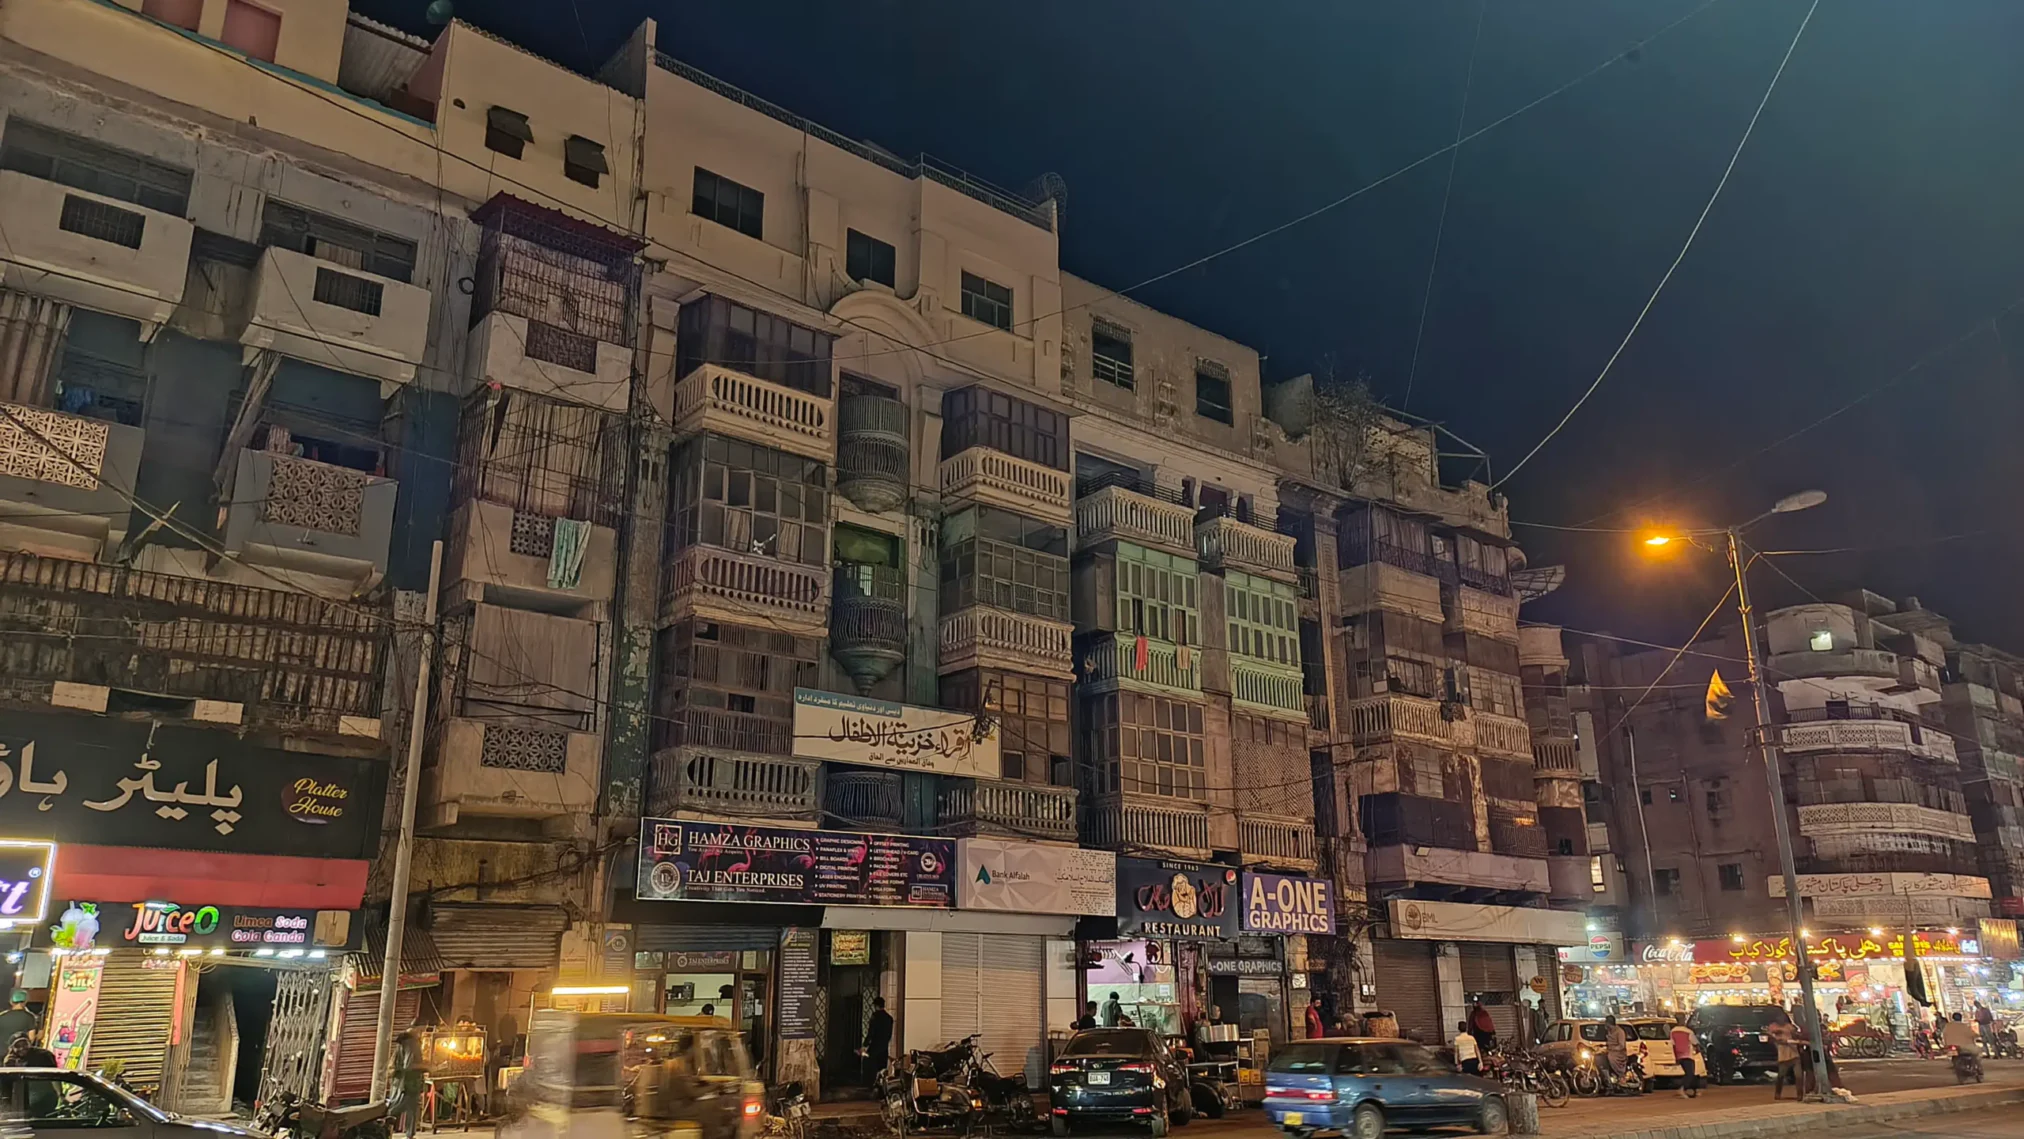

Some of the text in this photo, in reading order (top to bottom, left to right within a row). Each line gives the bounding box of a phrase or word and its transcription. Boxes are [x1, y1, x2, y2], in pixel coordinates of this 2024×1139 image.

[83, 752, 243, 836] پلیٹر
[294, 777, 348, 799] Platter
[289, 796, 343, 817] House
[688, 831, 810, 851] HAMZA GRAPHICS
[1162, 862, 1181, 870] SINCE
[686, 869, 711, 883] TAJ
[714, 870, 804, 887] ENTERPRISES
[992, 870, 1030, 880] Bank Alfalah
[1250, 876, 1328, 915] A-ONE
[274, 916, 307, 930] Soda
[1249, 910, 1329, 932] GRAPHICS
[262, 930, 306, 944] Ganda
[1144, 922, 1221, 937] RESTAURANT
[1208, 960, 1282, 974] A-ONE GRAPHICS
[63, 979, 96, 990] MILK
